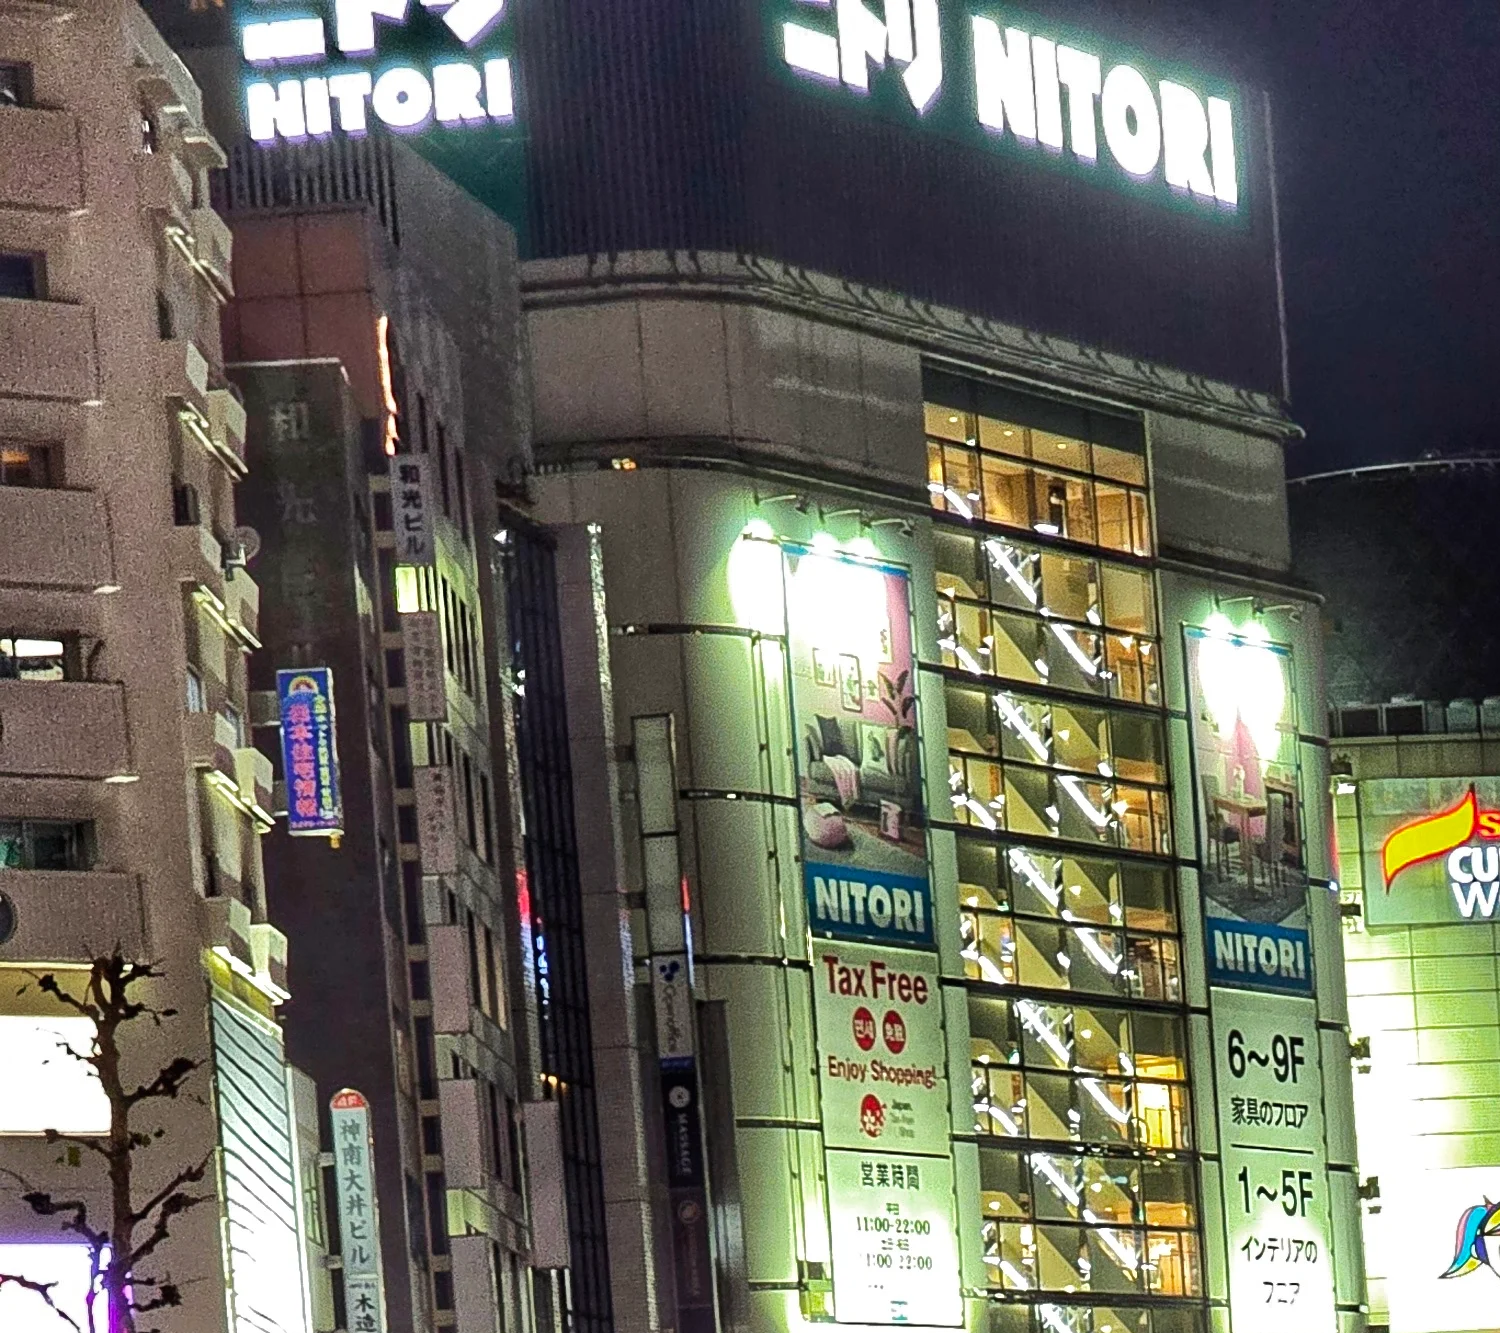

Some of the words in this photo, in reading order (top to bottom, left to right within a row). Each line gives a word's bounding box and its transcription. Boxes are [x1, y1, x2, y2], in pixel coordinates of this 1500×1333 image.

[246, 57, 513, 142] NITORI
[971, 14, 1238, 206] NITORI
[813, 875, 925, 934] NITORI
[1213, 929, 1306, 979] NITORI
[822, 954, 868, 998] Tax
[869, 959, 929, 1005] Free
[828, 1055, 868, 1083] Enjoy
[869, 1058, 938, 1090] Shopping!
[1231, 1097, 1308, 1128] 家具のフロア
[338, 1118, 371, 1264] 神南大井ビル
[861, 1161, 920, 1191] 営業時間
[856, 1216, 931, 1235] 11:00-22:00
[1241, 1235, 1318, 1264] インテリアの
